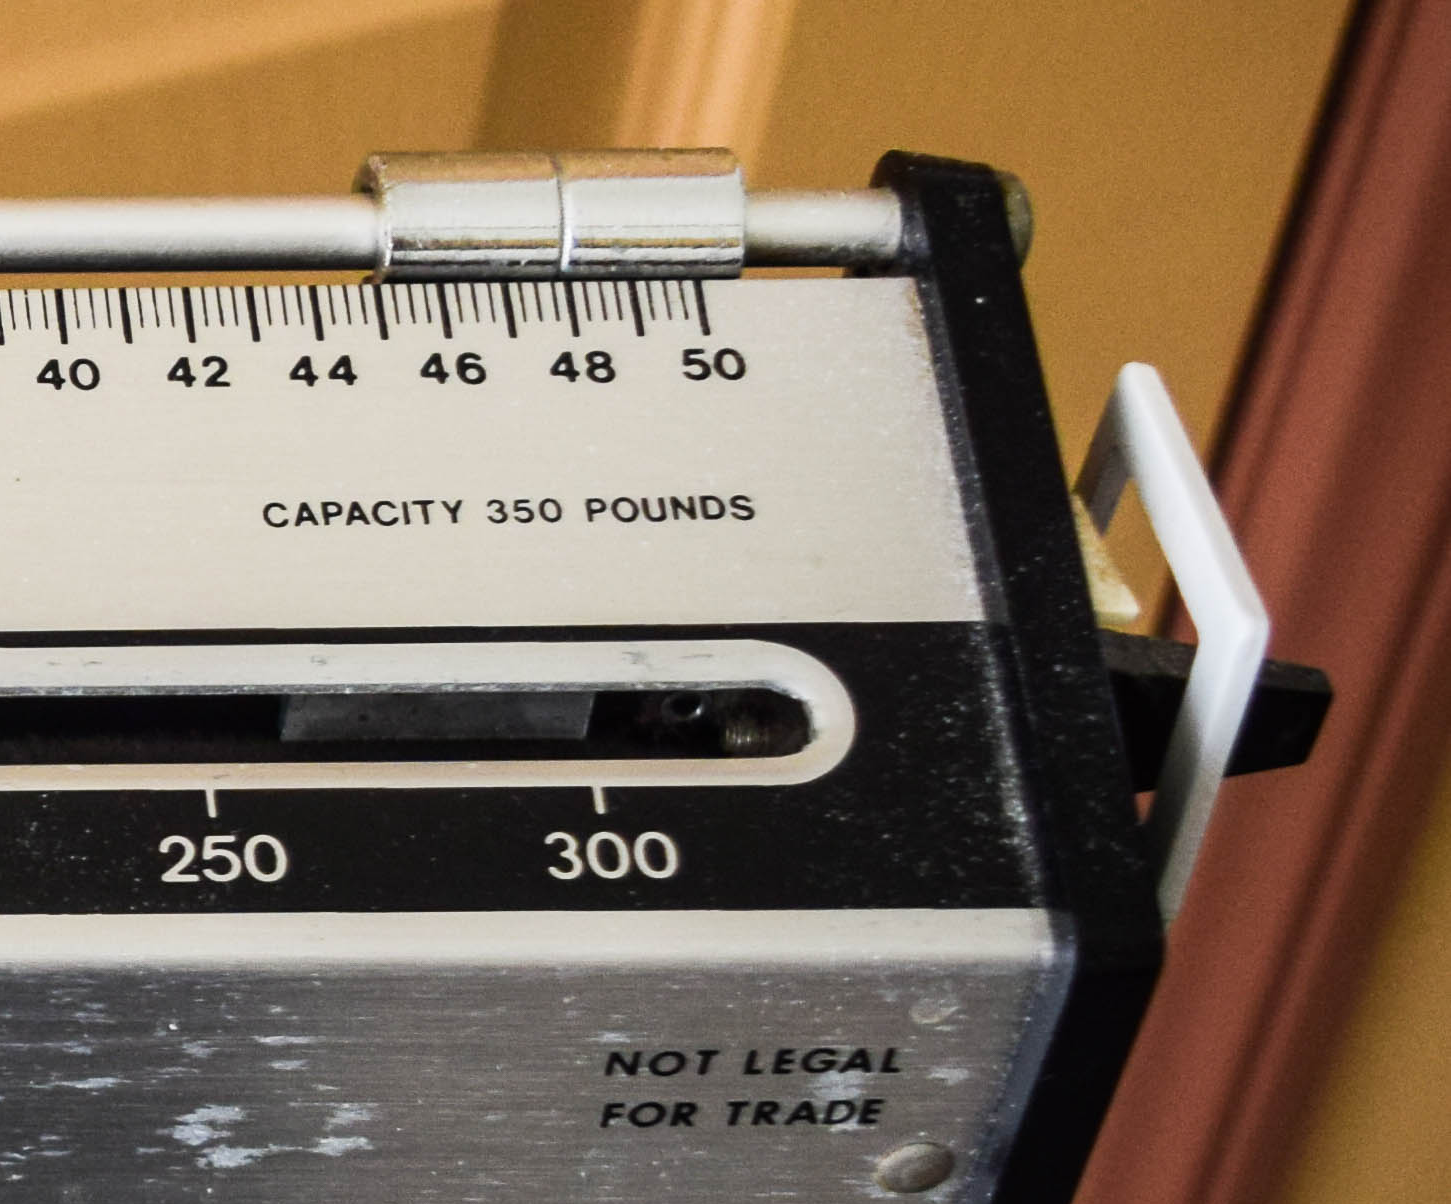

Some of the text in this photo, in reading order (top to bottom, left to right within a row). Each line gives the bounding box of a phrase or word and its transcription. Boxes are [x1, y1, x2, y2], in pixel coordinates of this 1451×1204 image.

[35, 357, 102, 392] 40
[166, 354, 232, 389] 42
[288, 353, 359, 389] 44
[419, 350, 488, 387] 46
[548, 349, 618, 385] 48
[681, 346, 748, 383] 50
[261, 493, 757, 530] CAPACITY 350 POUNDS
[157, 833, 289, 884] 250
[543, 830, 680, 881] 300
[603, 1046, 902, 1078] NOT LEGAL
[599, 1097, 886, 1130] FOR TRADE
